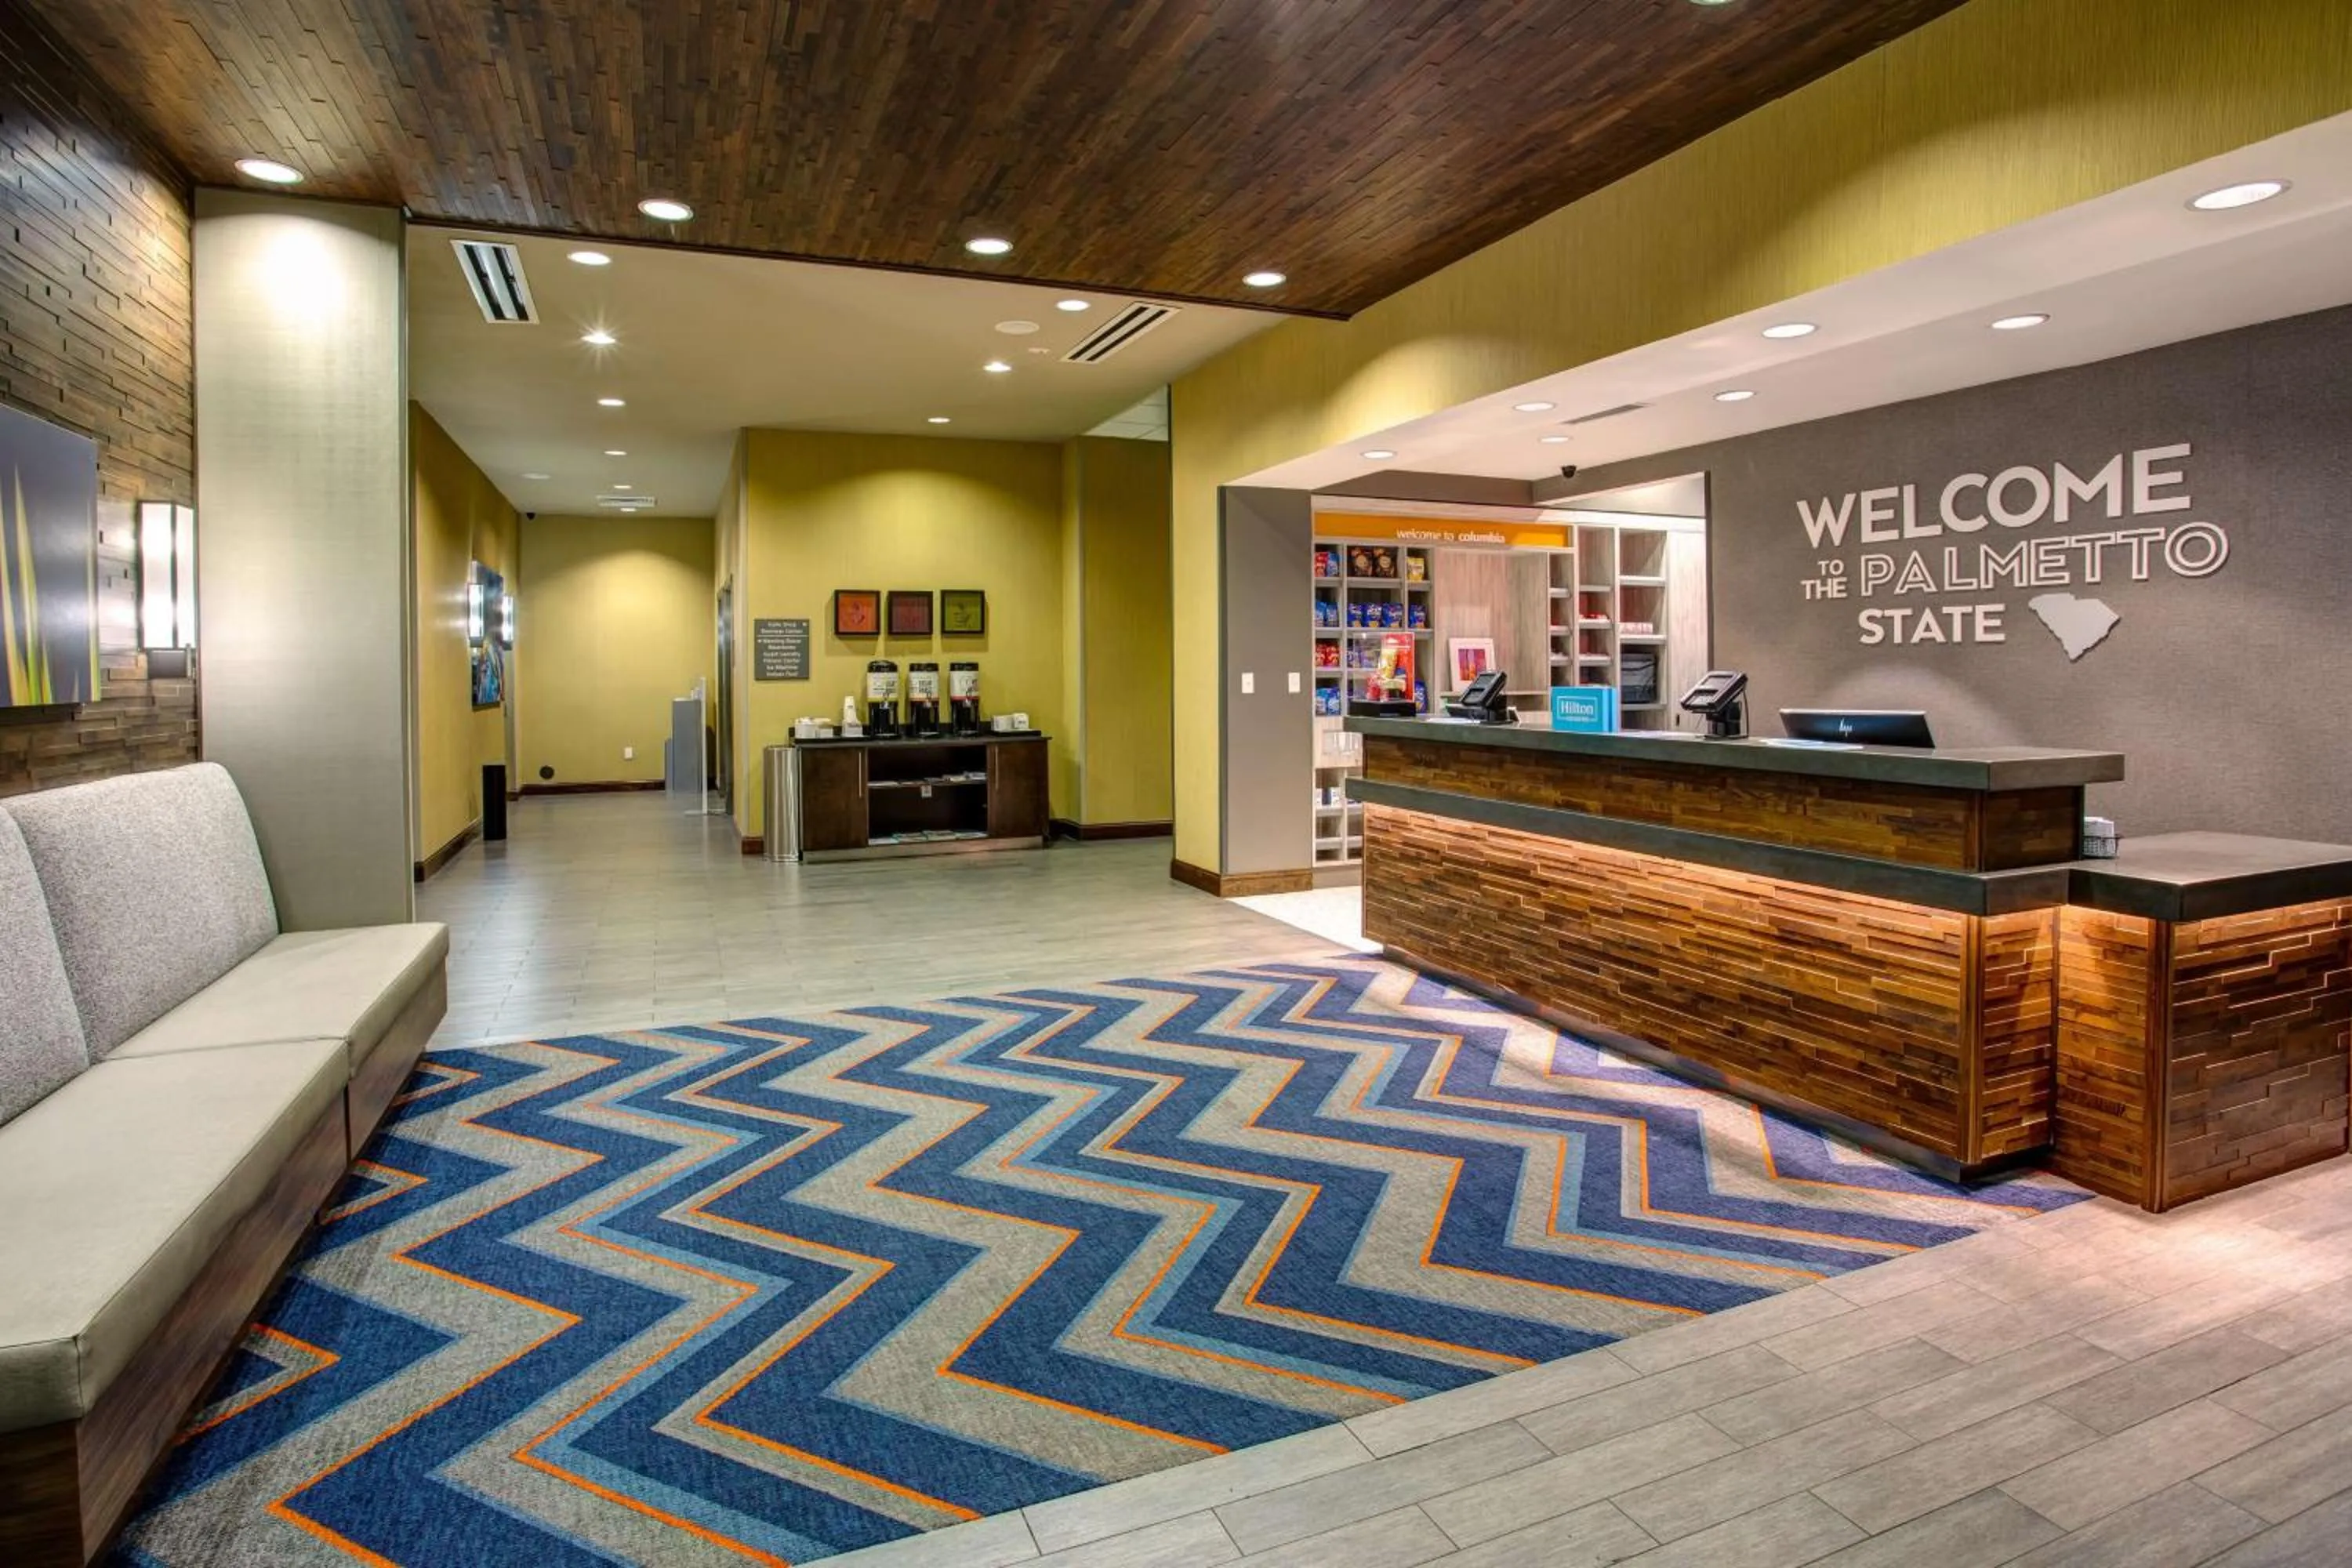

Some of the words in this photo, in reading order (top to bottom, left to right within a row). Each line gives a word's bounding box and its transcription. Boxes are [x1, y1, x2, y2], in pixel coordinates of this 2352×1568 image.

[1797, 443, 2192, 549] WELCOME
[1396, 528, 1442, 539] welcome
[1444, 531, 1454, 540] to
[1458, 530, 1505, 543] columbia
[1818, 560, 1845, 576] TO
[1860, 521, 2230, 597] PALMETTO
[1802, 578, 1848, 600] THE
[1858, 604, 2007, 644] STATE
[1561, 701, 1594, 715] Hilton
